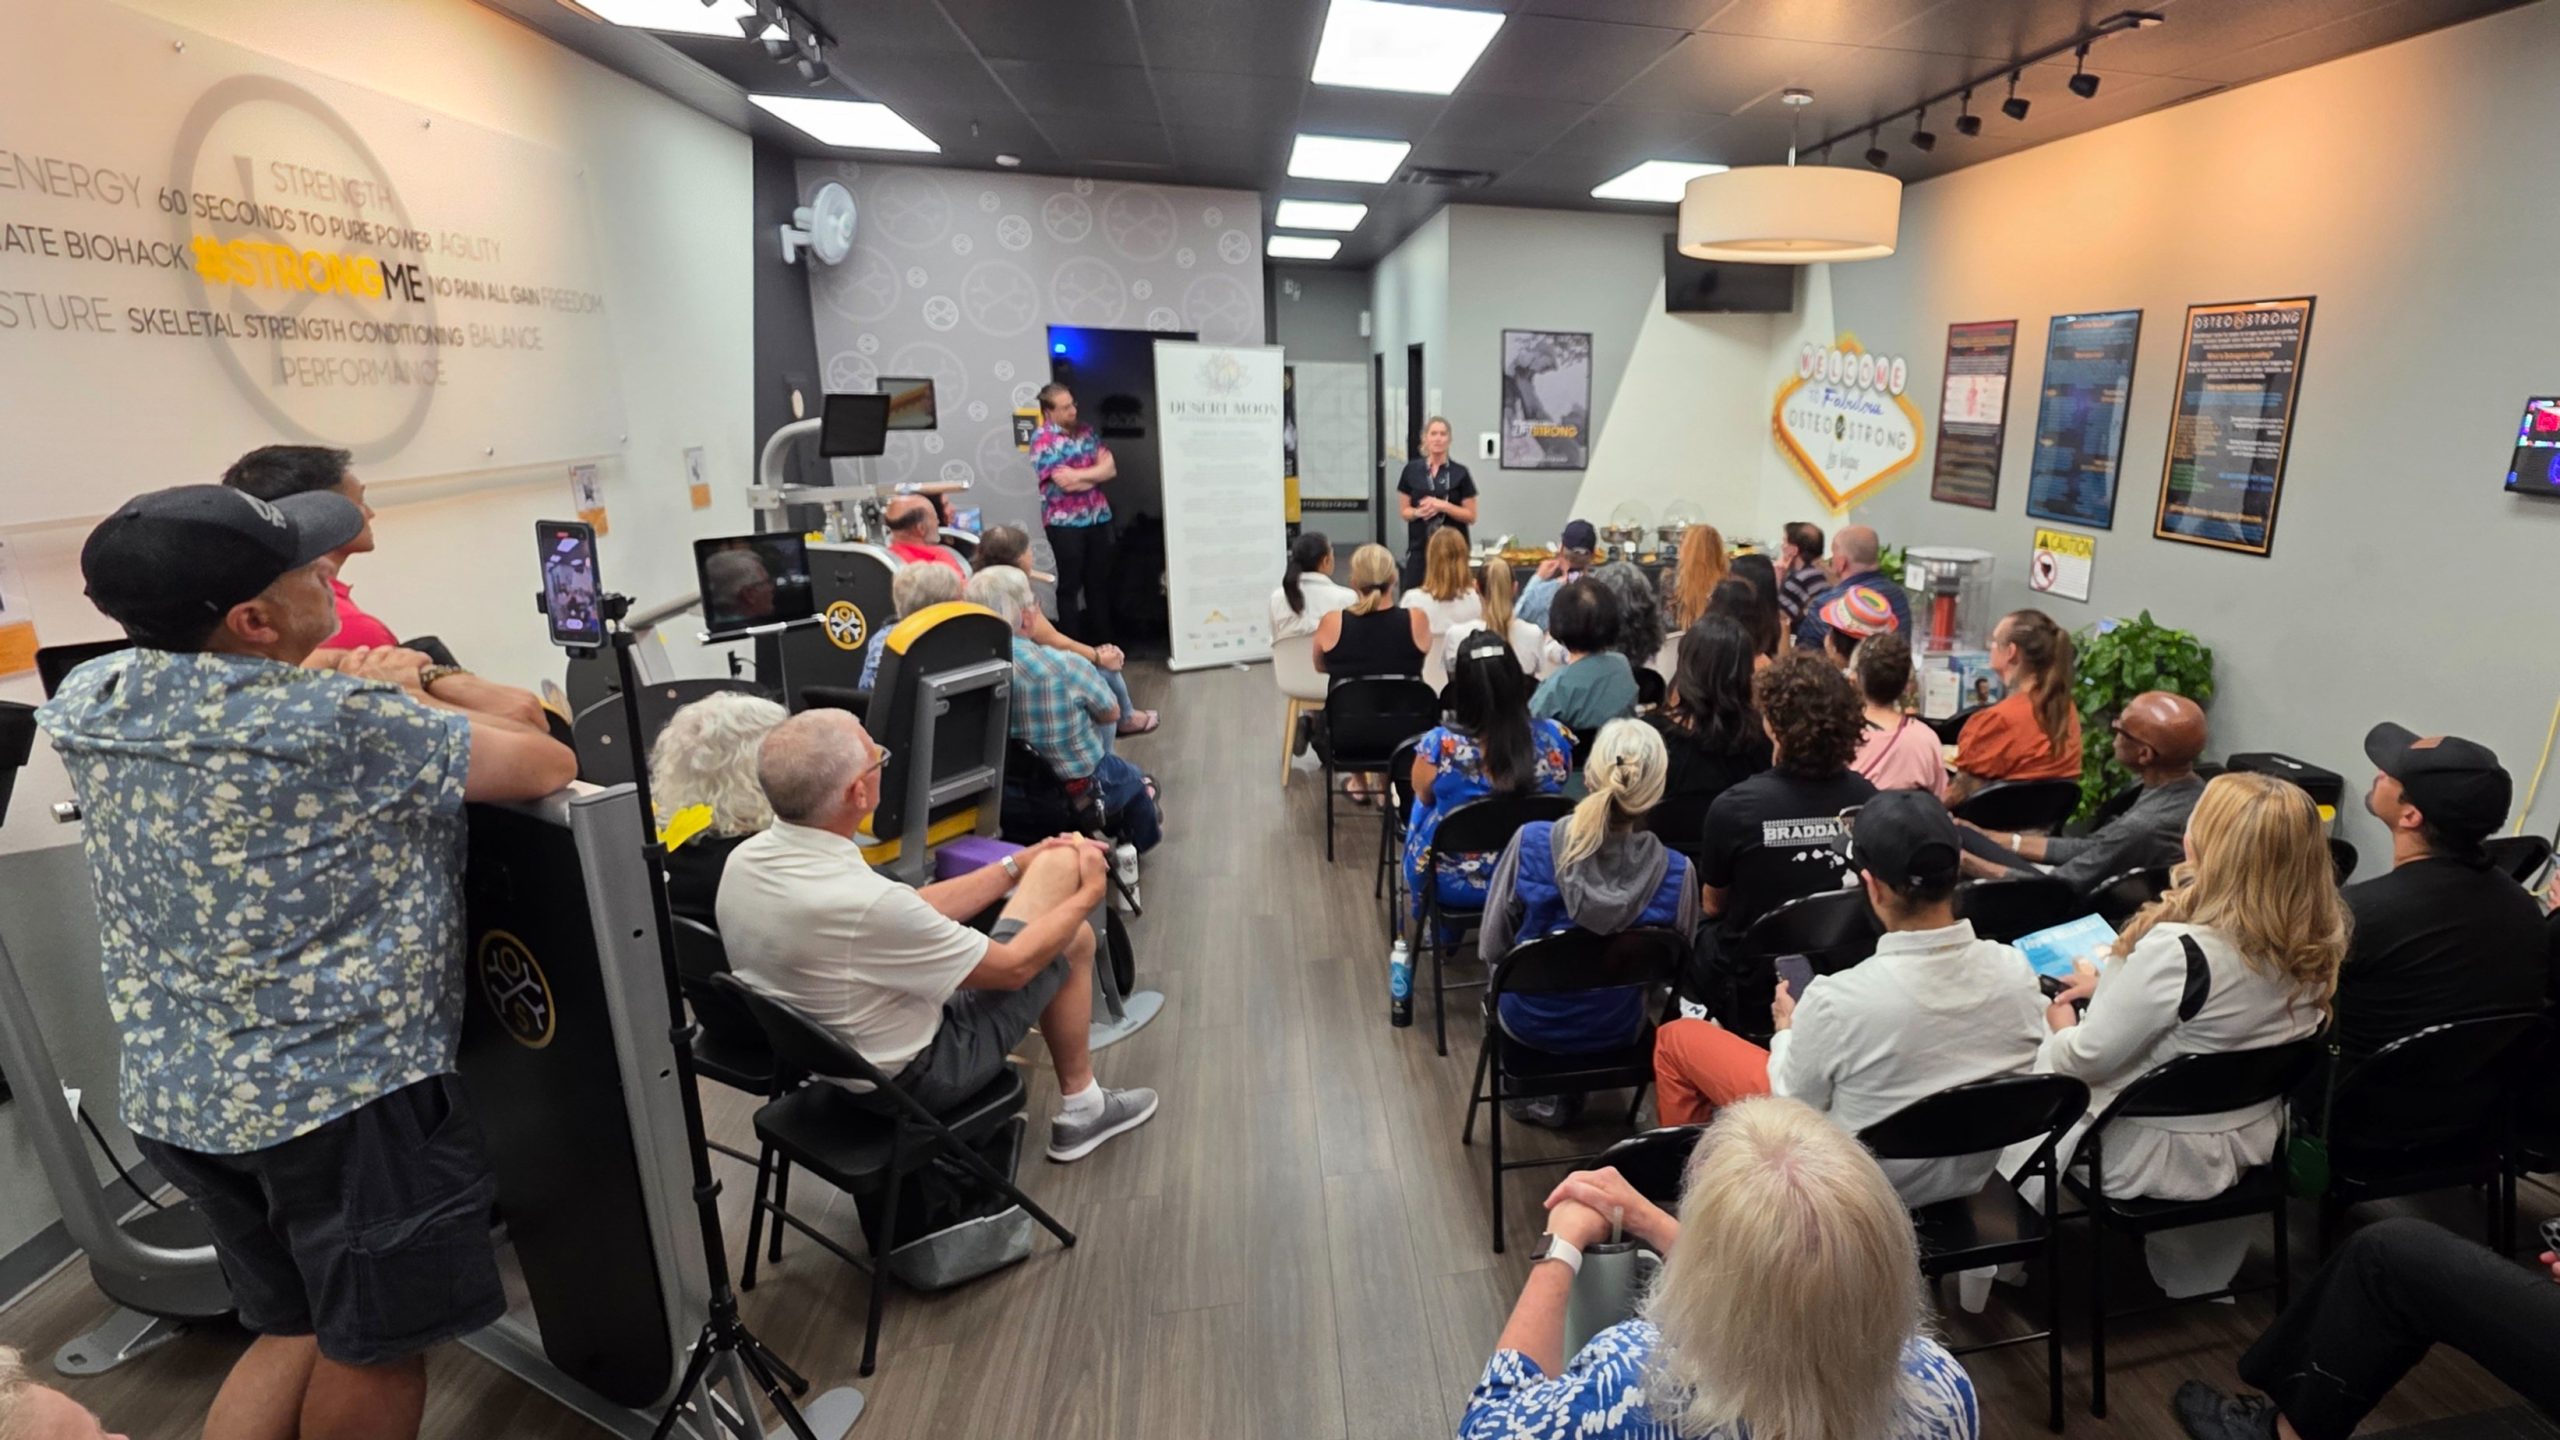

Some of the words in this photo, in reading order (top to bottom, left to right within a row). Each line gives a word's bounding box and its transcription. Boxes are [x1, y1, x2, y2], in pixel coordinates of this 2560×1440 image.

[270, 161, 395, 212] STRENGTH
[158, 186, 188, 215] 60
[192, 193, 297, 232] SECONDS
[299, 211, 326, 237] TO
[329, 216, 373, 245] PURE
[376, 225, 432, 254] POWER
[0, 223, 59, 257] ATE
[63, 229, 189, 271] BIOHACK
[440, 232, 500, 262] AGILITY
[428, 275, 452, 297] NO
[454, 278, 485, 301] PAIN
[488, 283, 509, 304] ALL
[510, 285, 540, 305] GAIN
[540, 286, 605, 315] FREEDOM
[128, 306, 241, 339] SKELETAL
[243, 313, 346, 342] STRENGTH
[349, 319, 465, 348] CONDITIONING
[468, 322, 544, 351] BALANCE
[281, 356, 447, 387] PERFORMANCE
[1800, 350, 1904, 391] WELCOME
[1764, 823, 1838, 841] BRADDA
